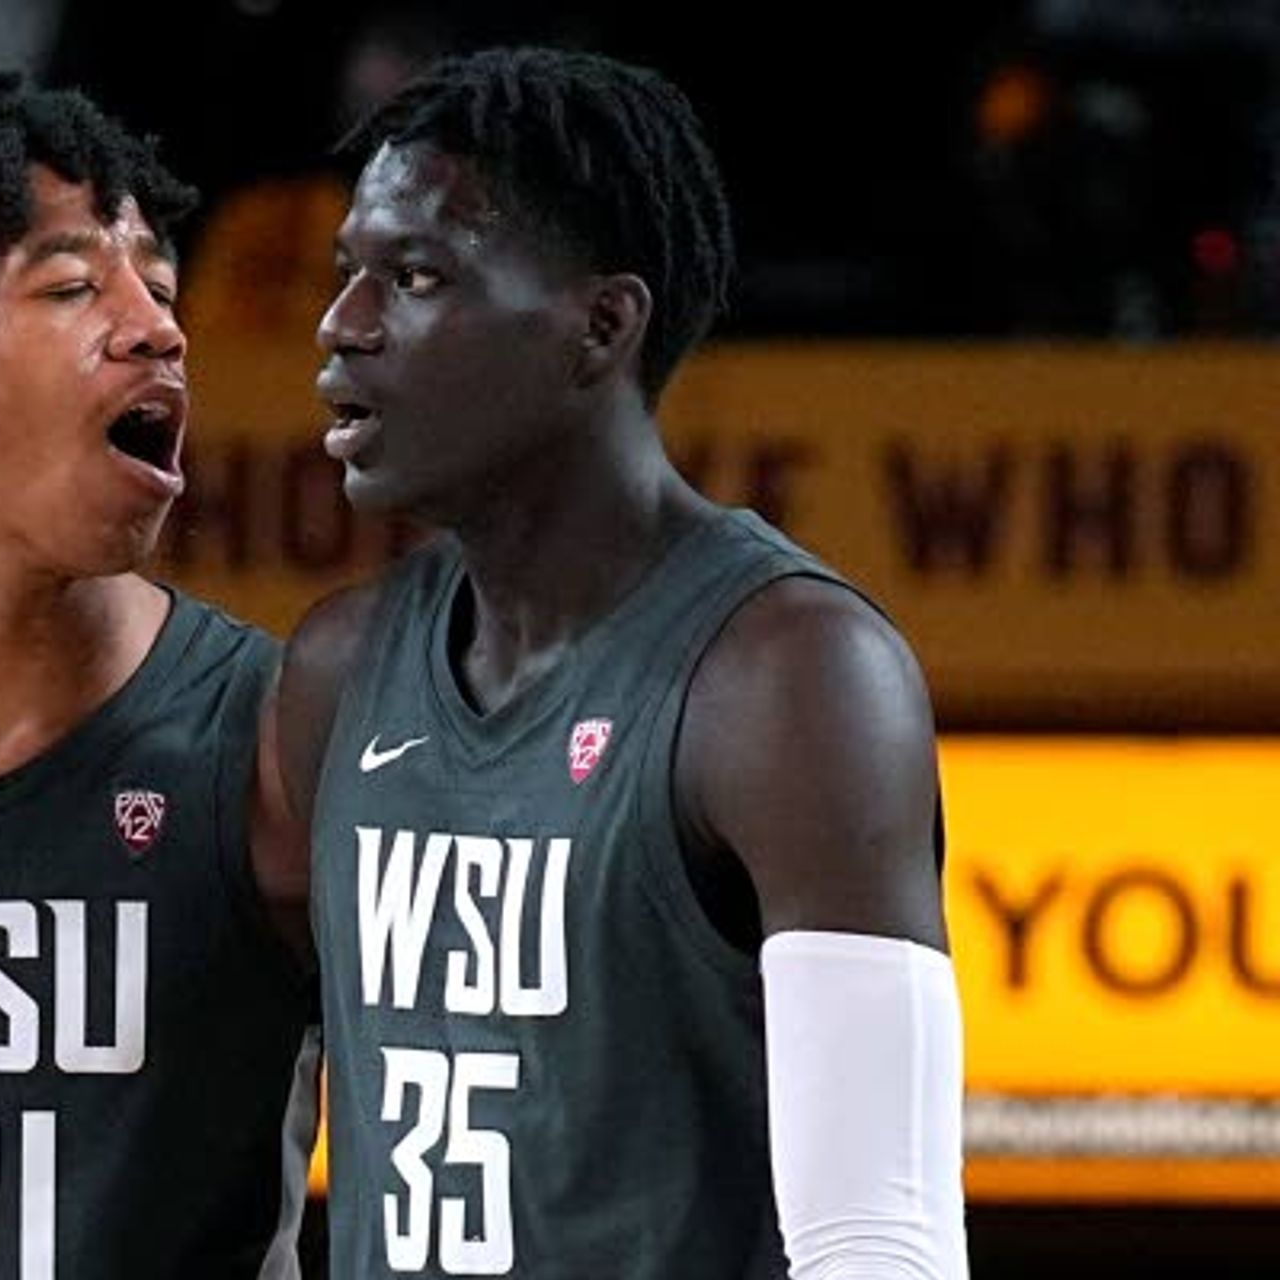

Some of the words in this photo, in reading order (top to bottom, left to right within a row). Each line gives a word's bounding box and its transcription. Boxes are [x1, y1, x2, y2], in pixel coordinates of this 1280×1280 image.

[884, 436, 1256, 582] WHO
[115, 791, 165, 829] PAC
[124, 816, 151, 840] 12
[355, 826, 571, 1016] WSU
[380, 1046, 520, 1275] 35
